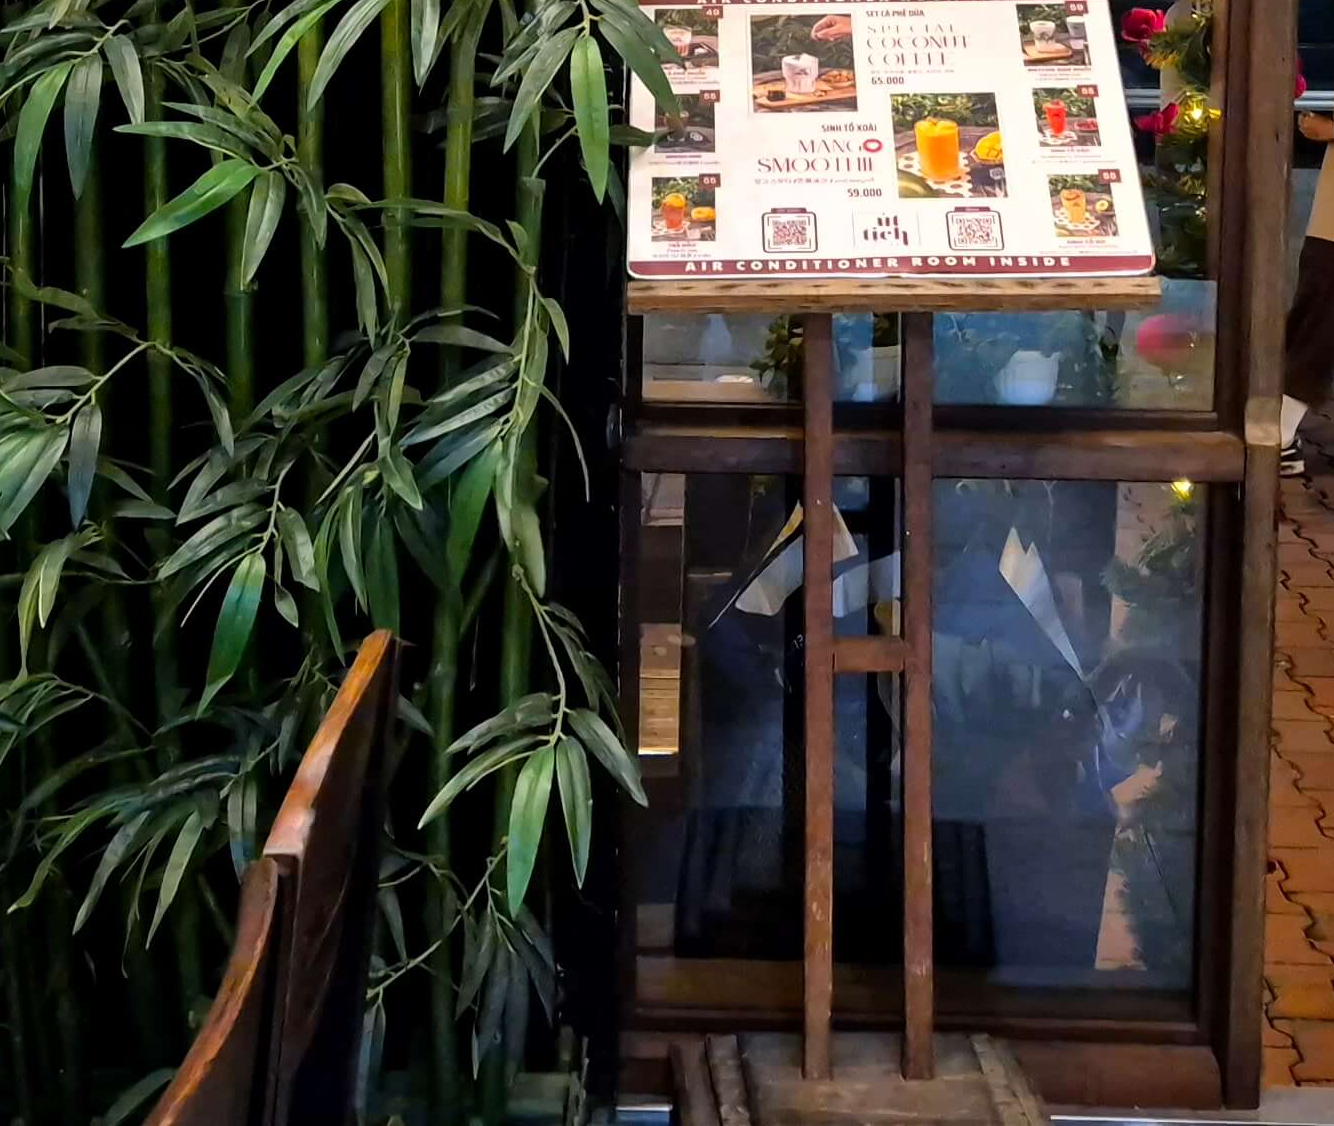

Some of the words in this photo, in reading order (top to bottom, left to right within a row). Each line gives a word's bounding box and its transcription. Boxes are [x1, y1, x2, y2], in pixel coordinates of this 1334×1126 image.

[867, 35, 970, 49] COCONUT
[871, 76, 905, 85] 65.000
[821, 124, 843, 133] SINH
[798, 138, 883, 153] MANGO
[847, 188, 883, 197] 59.000
[685, 261, 723, 271] AIR
[736, 257, 898, 271] CONDITIONER
[911, 256, 976, 266] ROOM
[989, 256, 1070, 267] INSIDE
